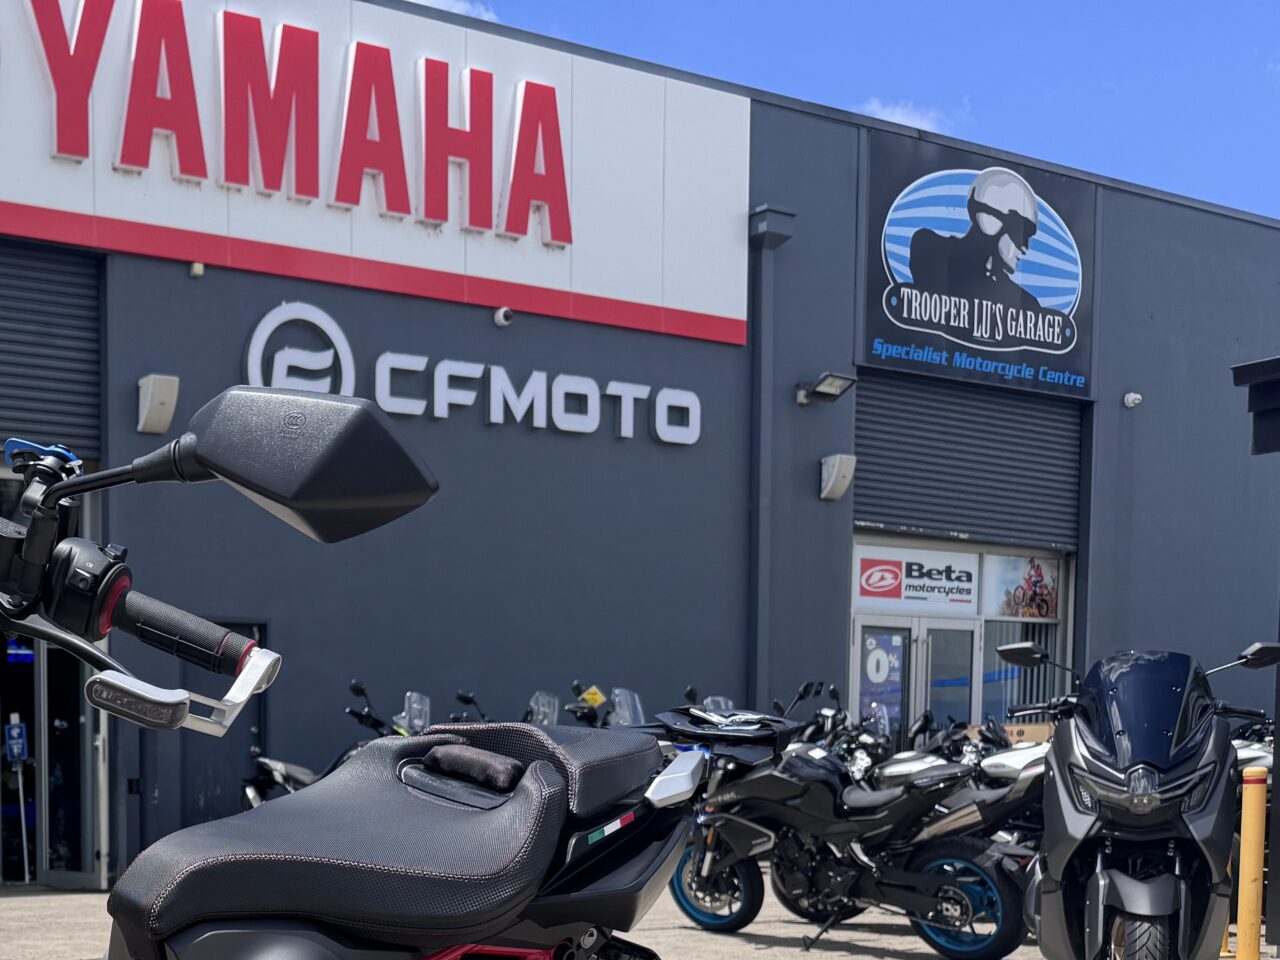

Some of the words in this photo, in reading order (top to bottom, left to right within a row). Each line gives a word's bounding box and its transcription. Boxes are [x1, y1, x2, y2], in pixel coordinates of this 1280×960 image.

[32, 0, 573, 249] YAMAHA
[900, 287, 969, 328] TROOPER
[972, 299, 1003, 342] LU'S
[1007, 307, 1062, 344] GARAGE
[872, 338, 948, 366] Specialist
[953, 351, 1035, 379] Motorcycle
[1038, 366, 1085, 387] Centre
[374, 351, 701, 445] CFMOTO
[904, 583, 972, 597] motorcycles
[905, 561, 972, 583] Beta
[867, 648, 899, 684] 0%
